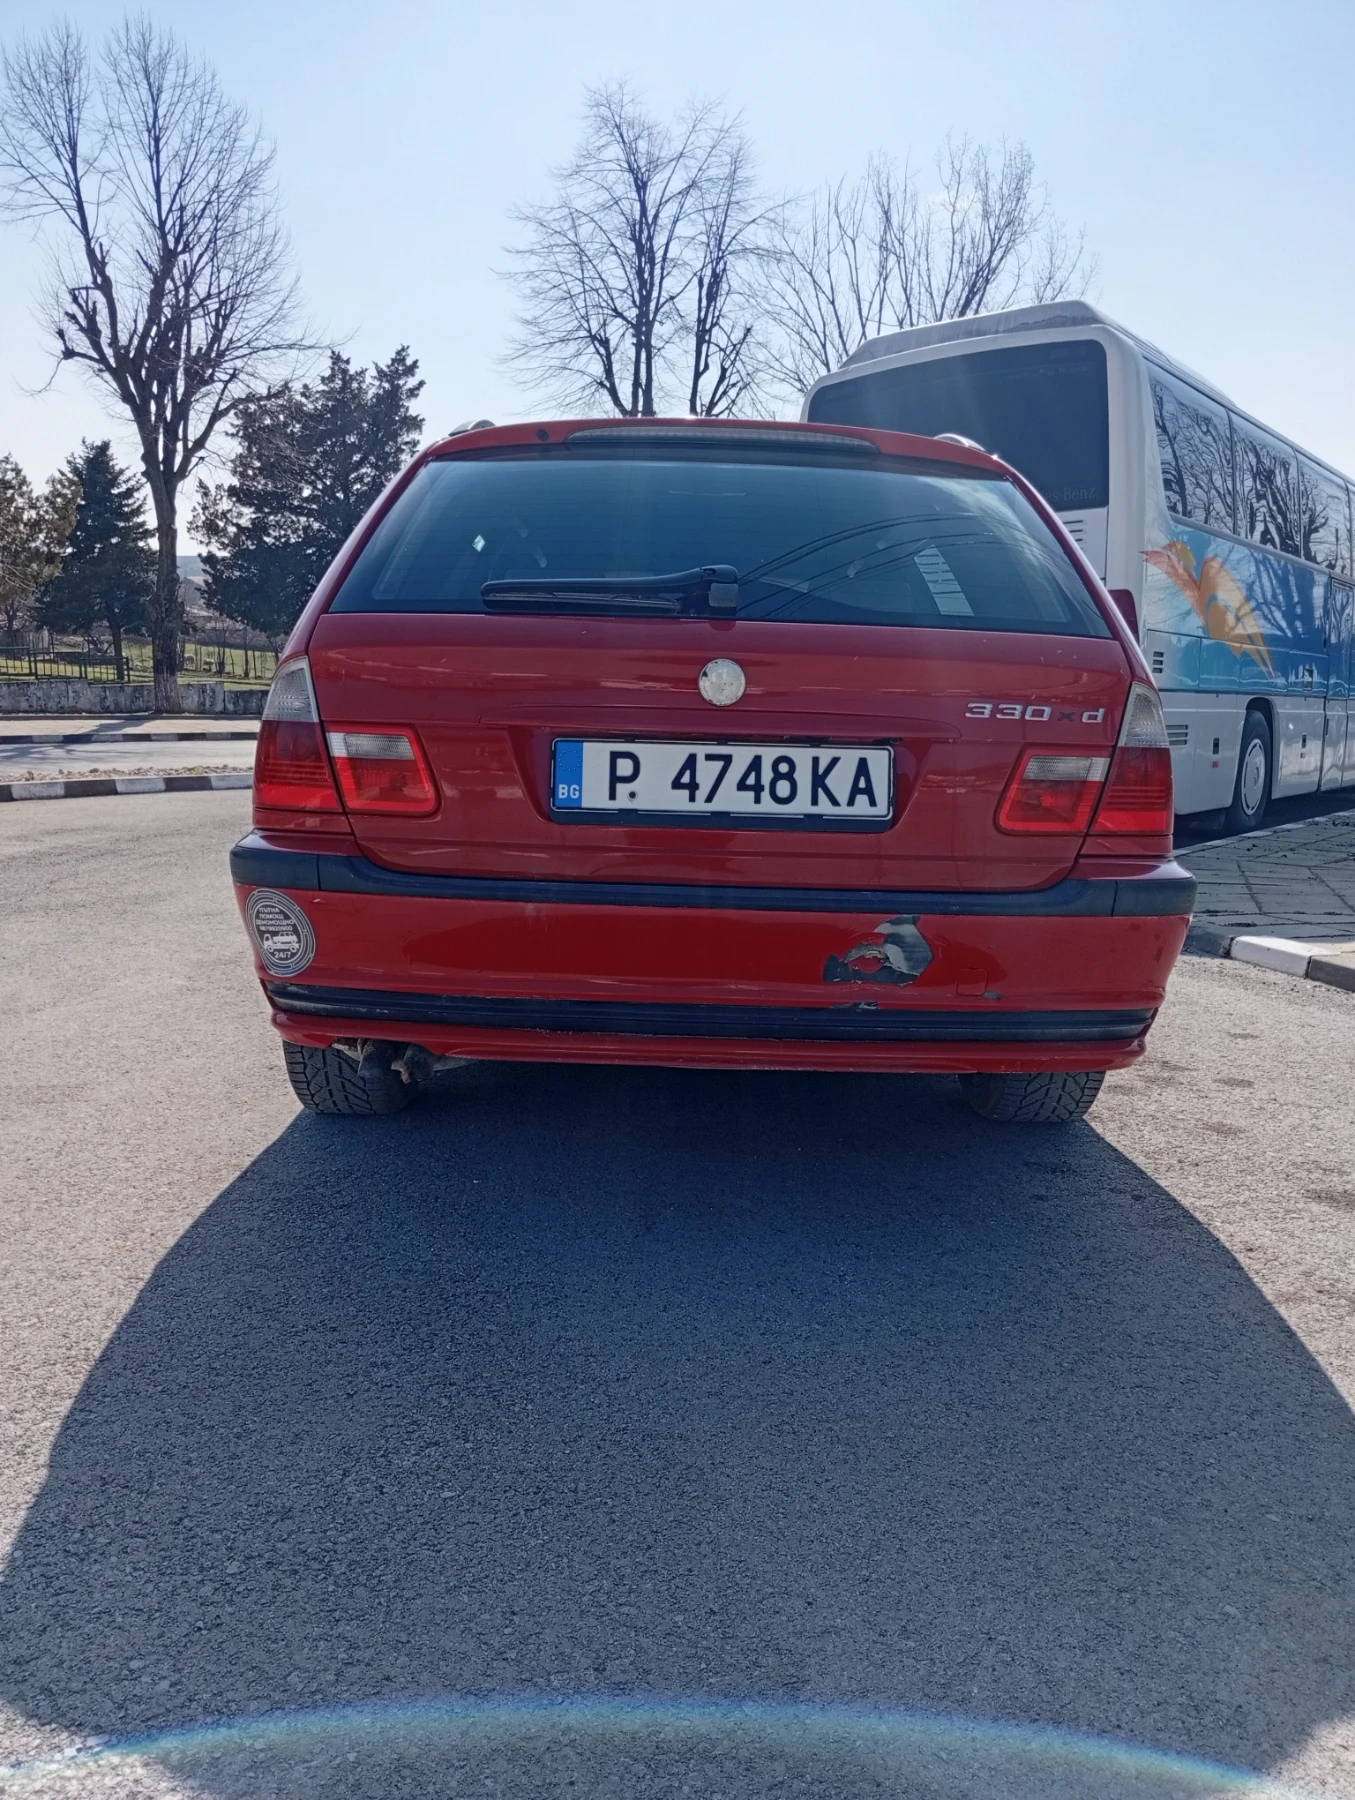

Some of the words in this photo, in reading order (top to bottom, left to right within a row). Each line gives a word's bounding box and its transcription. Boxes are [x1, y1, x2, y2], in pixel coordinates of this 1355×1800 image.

[1041, 487, 1097, 502] es-Benz
[558, 784, 580, 799] BG
[273, 951, 291, 959] 24/7
